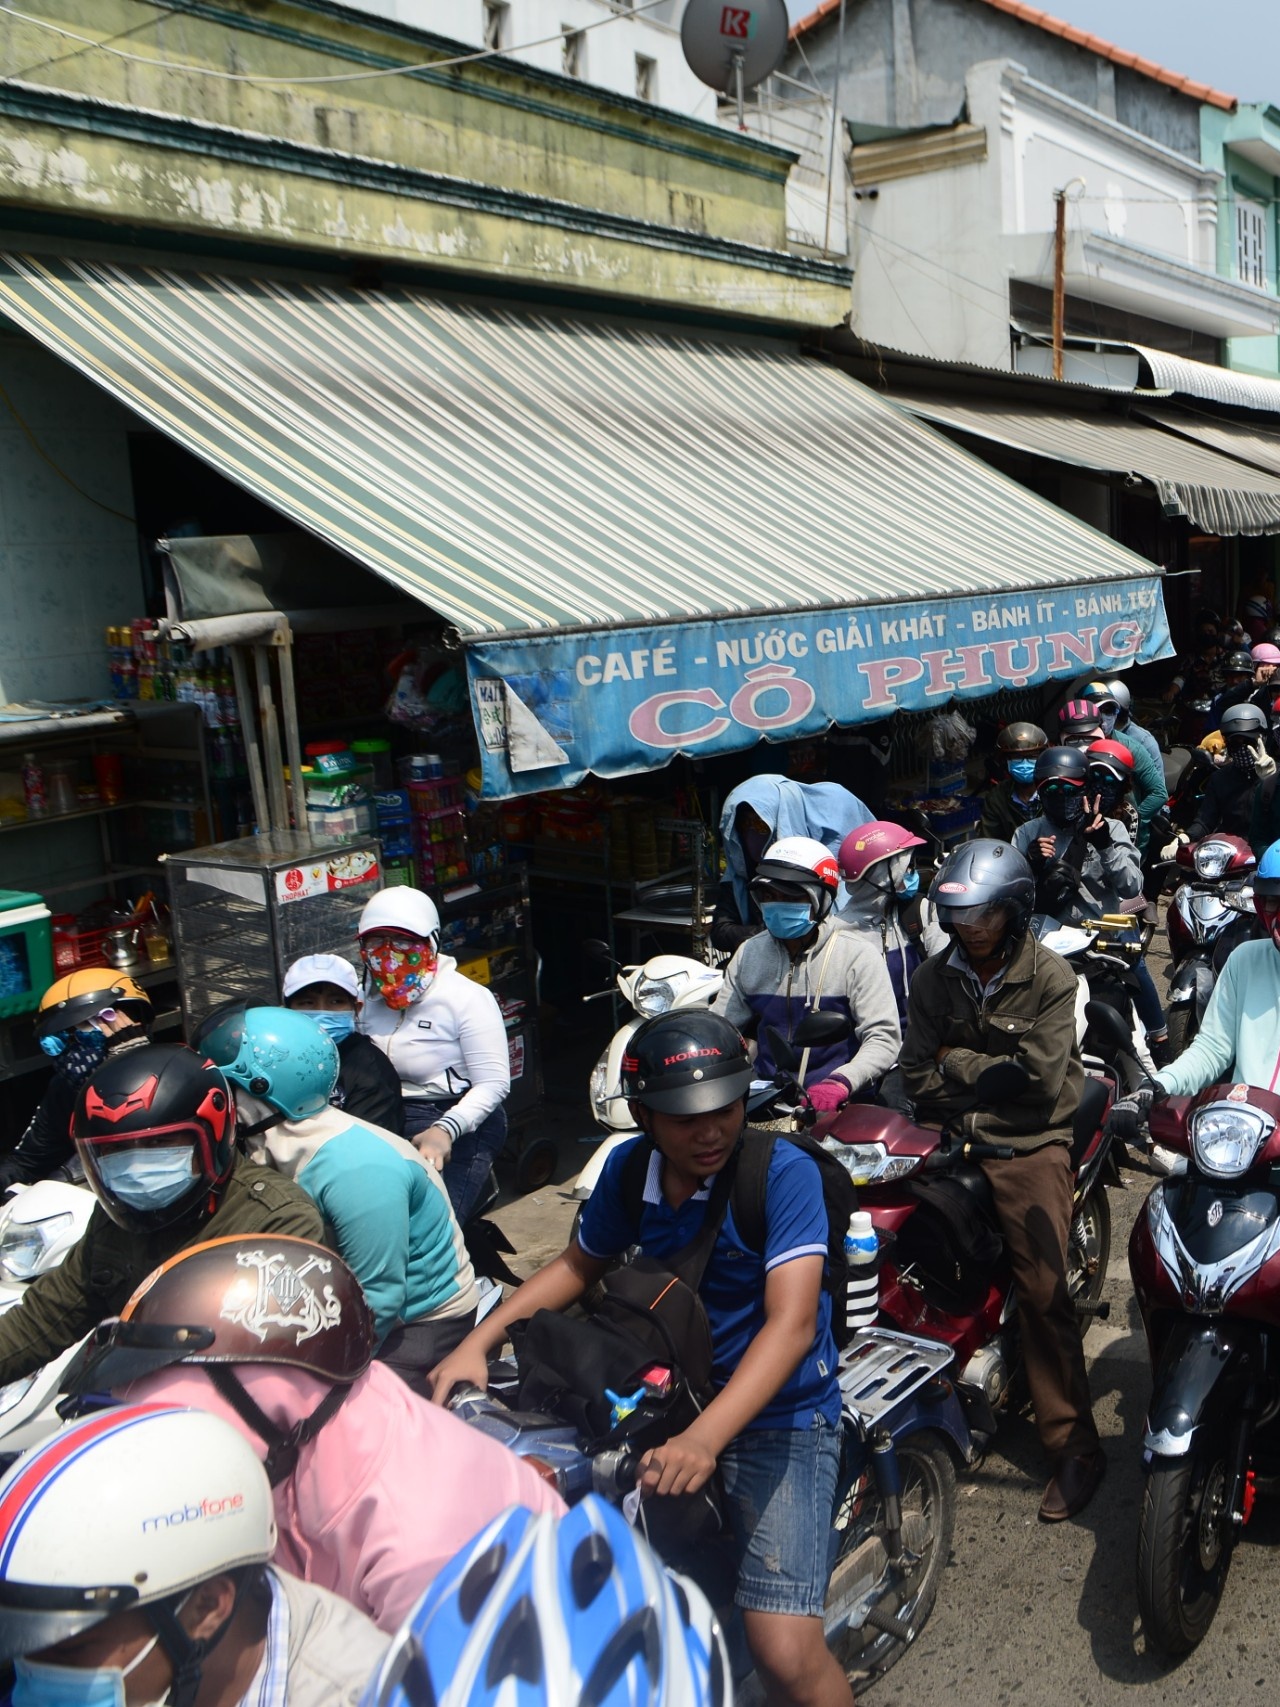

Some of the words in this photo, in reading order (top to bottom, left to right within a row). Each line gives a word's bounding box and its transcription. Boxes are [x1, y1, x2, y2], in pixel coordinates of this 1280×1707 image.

[575, 639, 678, 687] CAFÉ
[716, 627, 809, 669] NƯỚC
[815, 616, 873, 654] GIẢI
[881, 610, 947, 645] KHÁT
[972, 603, 1031, 632] BÁNH
[1036, 599, 1056, 624] ÍT
[1075, 592, 1123, 618] BÁNH
[628, 663, 816, 748] CÔ
[856, 620, 1147, 710] PHỤNG
[664, 1047, 722, 1066] HONDA
[142, 1494, 243, 1534] mobifone
